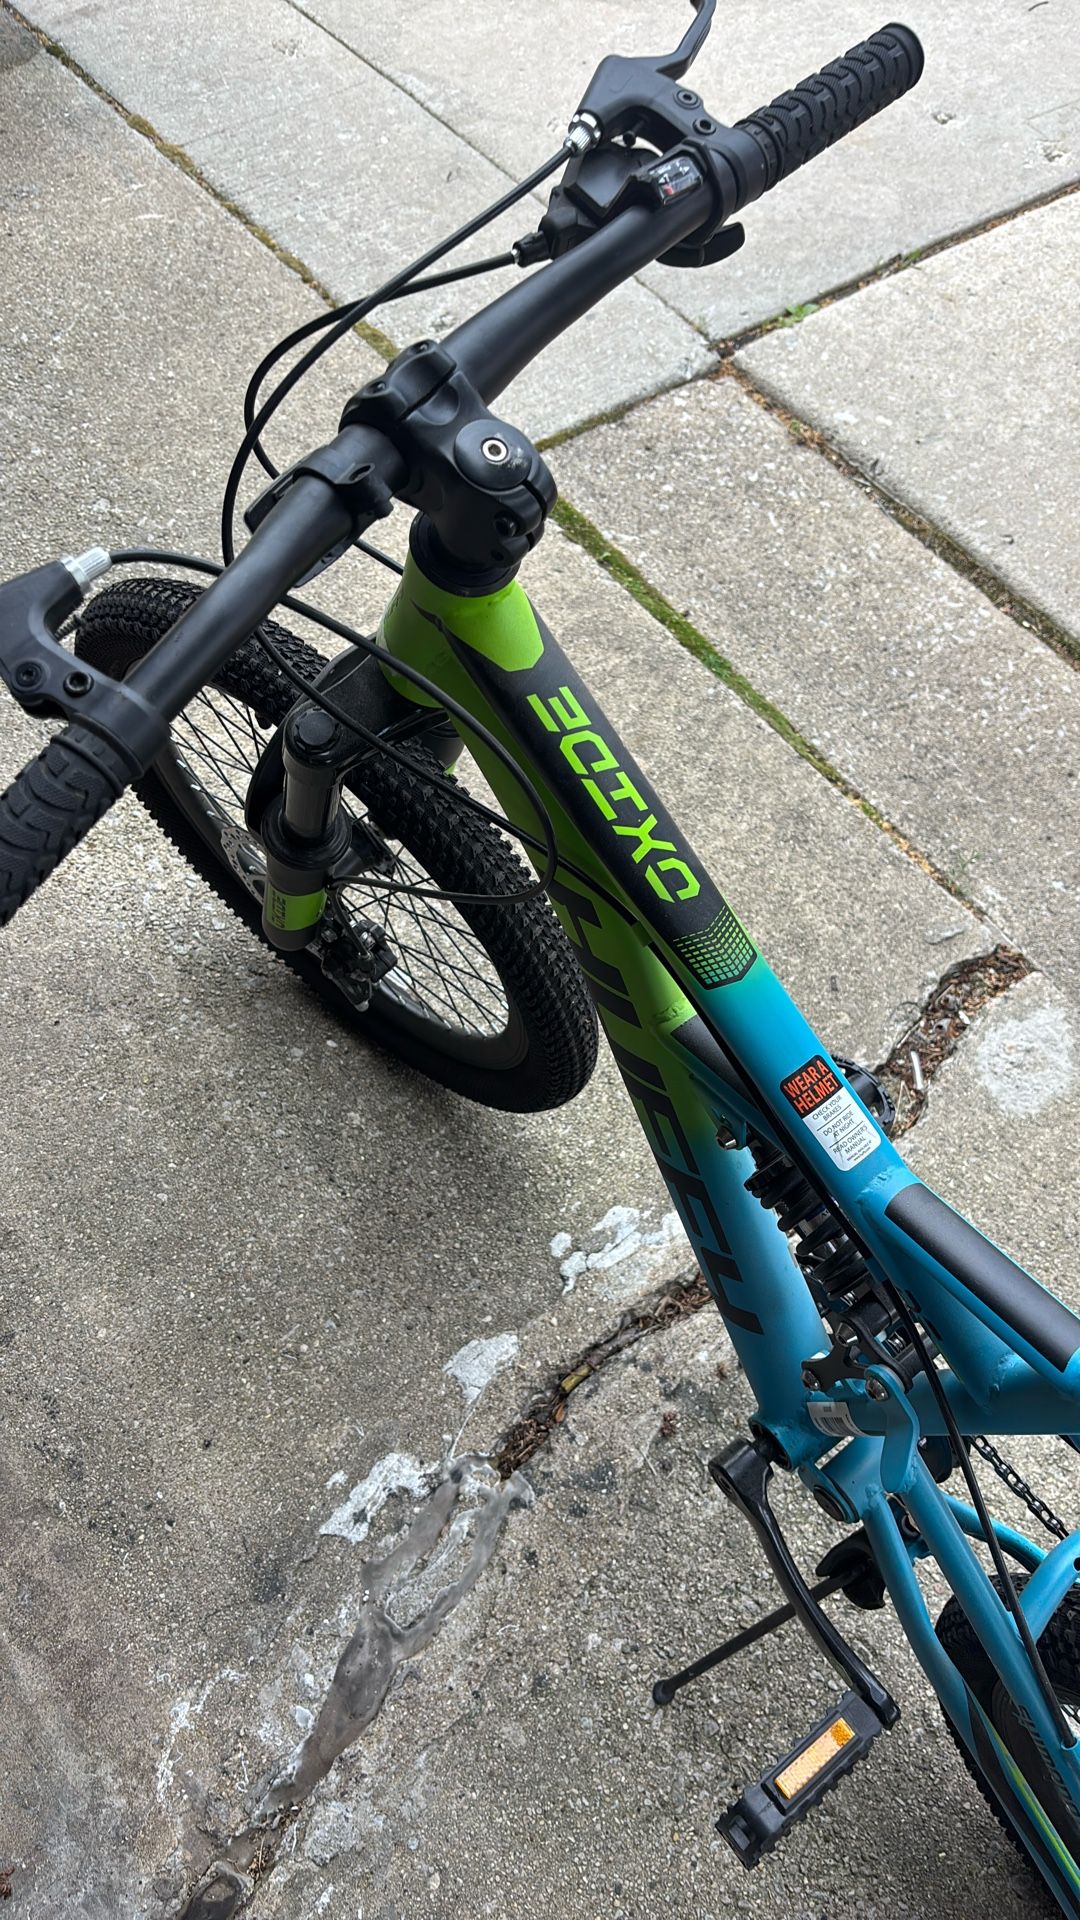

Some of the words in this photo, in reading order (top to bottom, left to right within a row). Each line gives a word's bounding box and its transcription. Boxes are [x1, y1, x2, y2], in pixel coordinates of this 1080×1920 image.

[526, 686, 701, 903] OXIDE
[783, 1066, 819, 1098] WEAR
[816, 1060, 829, 1076] A
[537, 868, 764, 1335] HUFFY
[793, 1072, 839, 1113] HELMET
[812, 1105, 830, 1121] CHECK
[828, 1095, 843, 1108] YOUR
[822, 1105, 842, 1121] BRAKES
[822, 1126, 834, 1137] DO
[832, 1118, 844, 1130] NOT
[842, 1111, 854, 1122] RIDE
[833, 1130, 840, 1138] AT
[839, 1119, 855, 1134] NIGHT
[832, 1140, 848, 1154] READ
[844, 1137, 866, 1155] MANUAL
